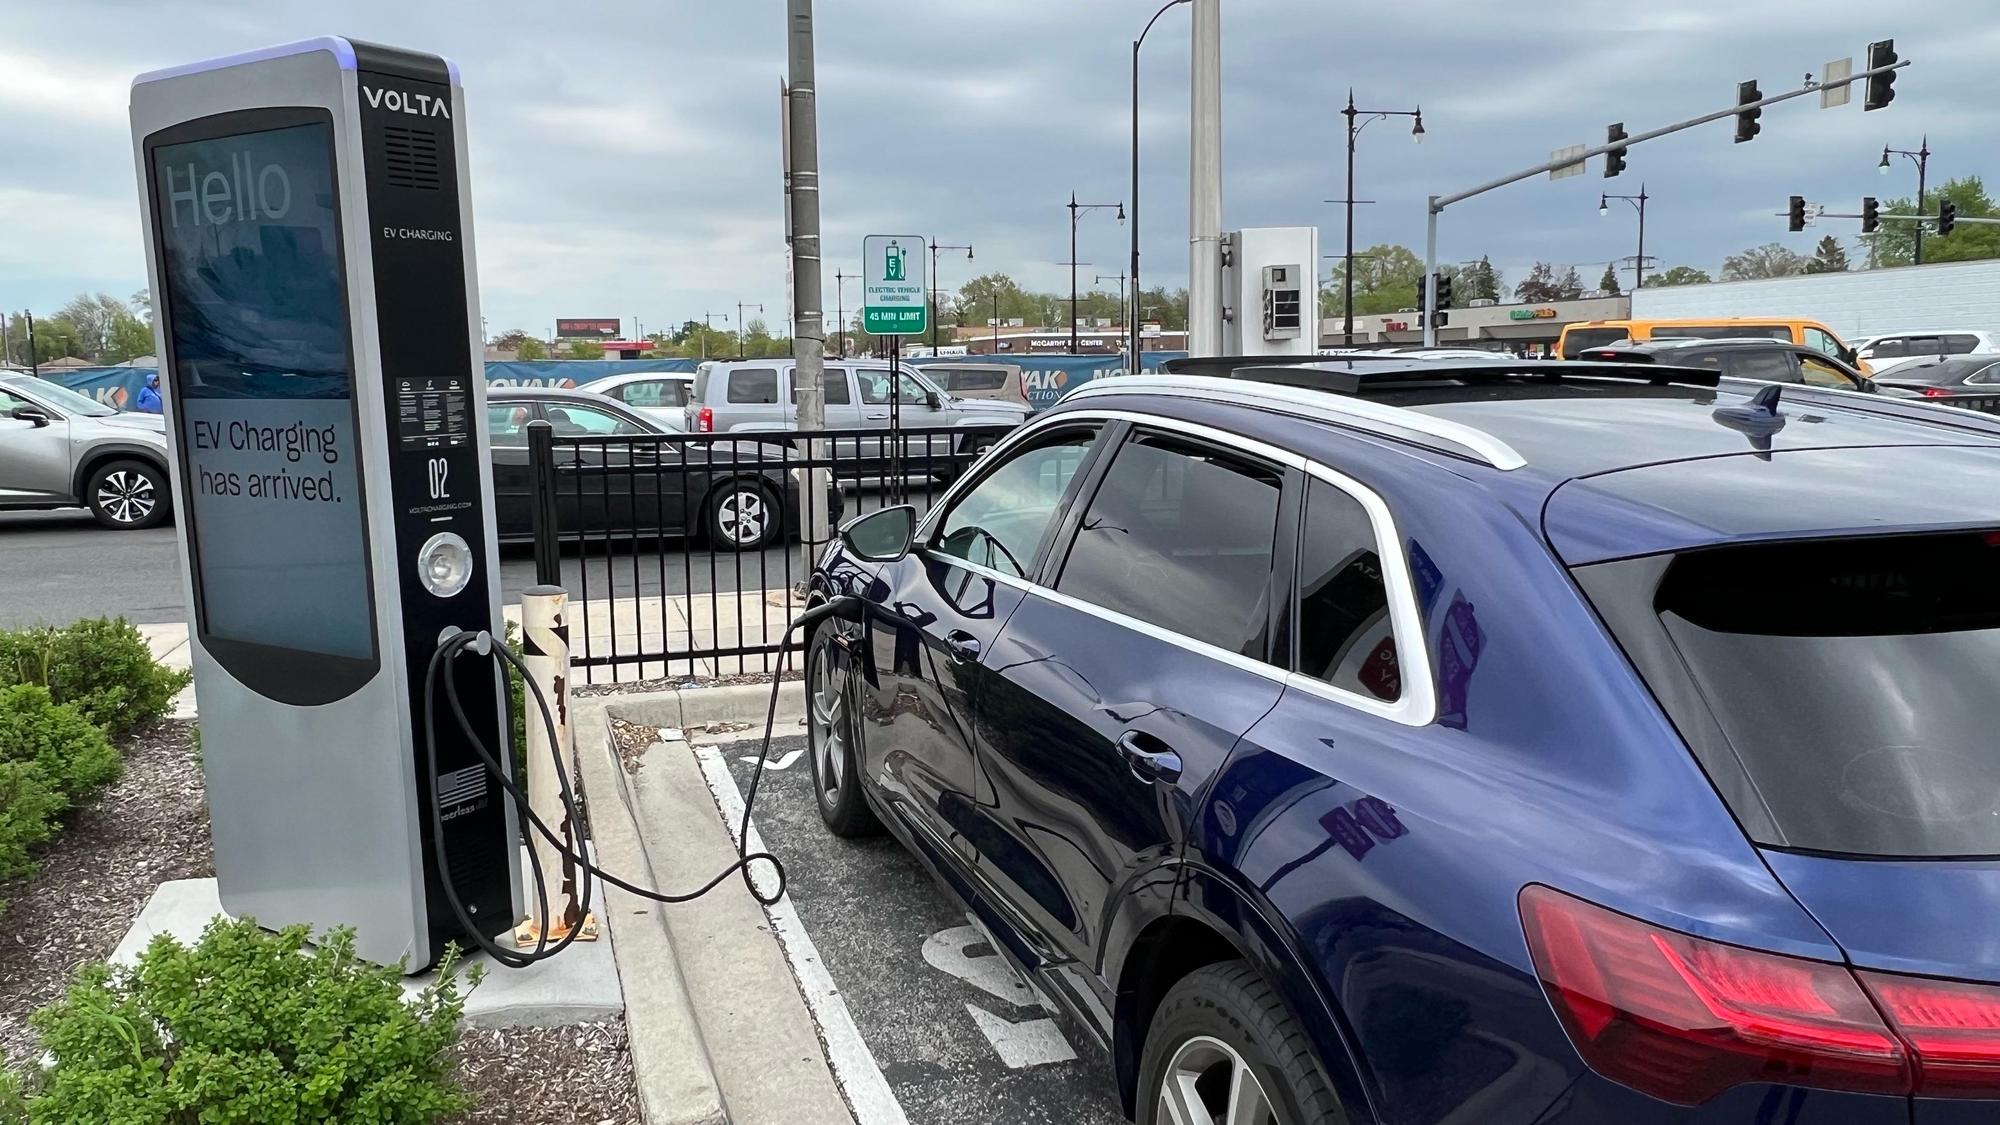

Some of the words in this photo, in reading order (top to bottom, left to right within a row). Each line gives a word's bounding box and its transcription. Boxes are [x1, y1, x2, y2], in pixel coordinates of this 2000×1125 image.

[363, 86, 450, 119] VOLTA
[166, 150, 291, 228] Hello
[384, 227, 397, 239] EV
[400, 228, 453, 241] CHARGING
[870, 312, 879, 320] 45
[881, 312, 897, 320] MIN
[899, 312, 920, 320] LIMIT
[194, 420, 221, 449] EV
[229, 420, 338, 463] Charging
[199, 464, 241, 496] has
[248, 468, 342, 503] arrived.
[428, 458, 450, 499] 02
